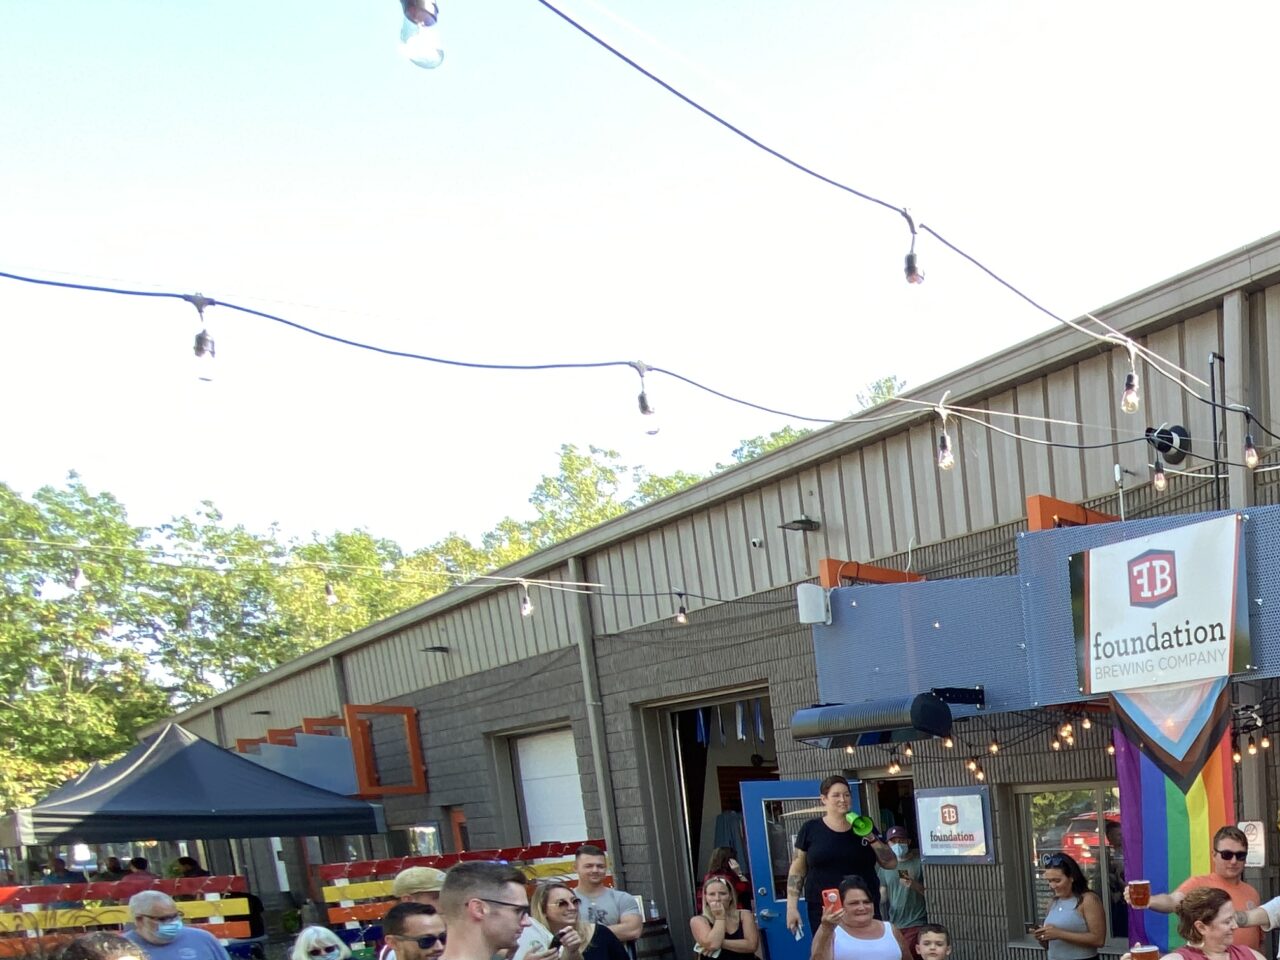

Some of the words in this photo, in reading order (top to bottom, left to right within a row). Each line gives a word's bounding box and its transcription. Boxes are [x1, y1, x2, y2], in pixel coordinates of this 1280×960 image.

[1093, 620, 1227, 660] foundation
[1095, 657, 1154, 680] BREWING
[1158, 648, 1227, 671] COMPANY
[930, 830, 974, 842] foundation
